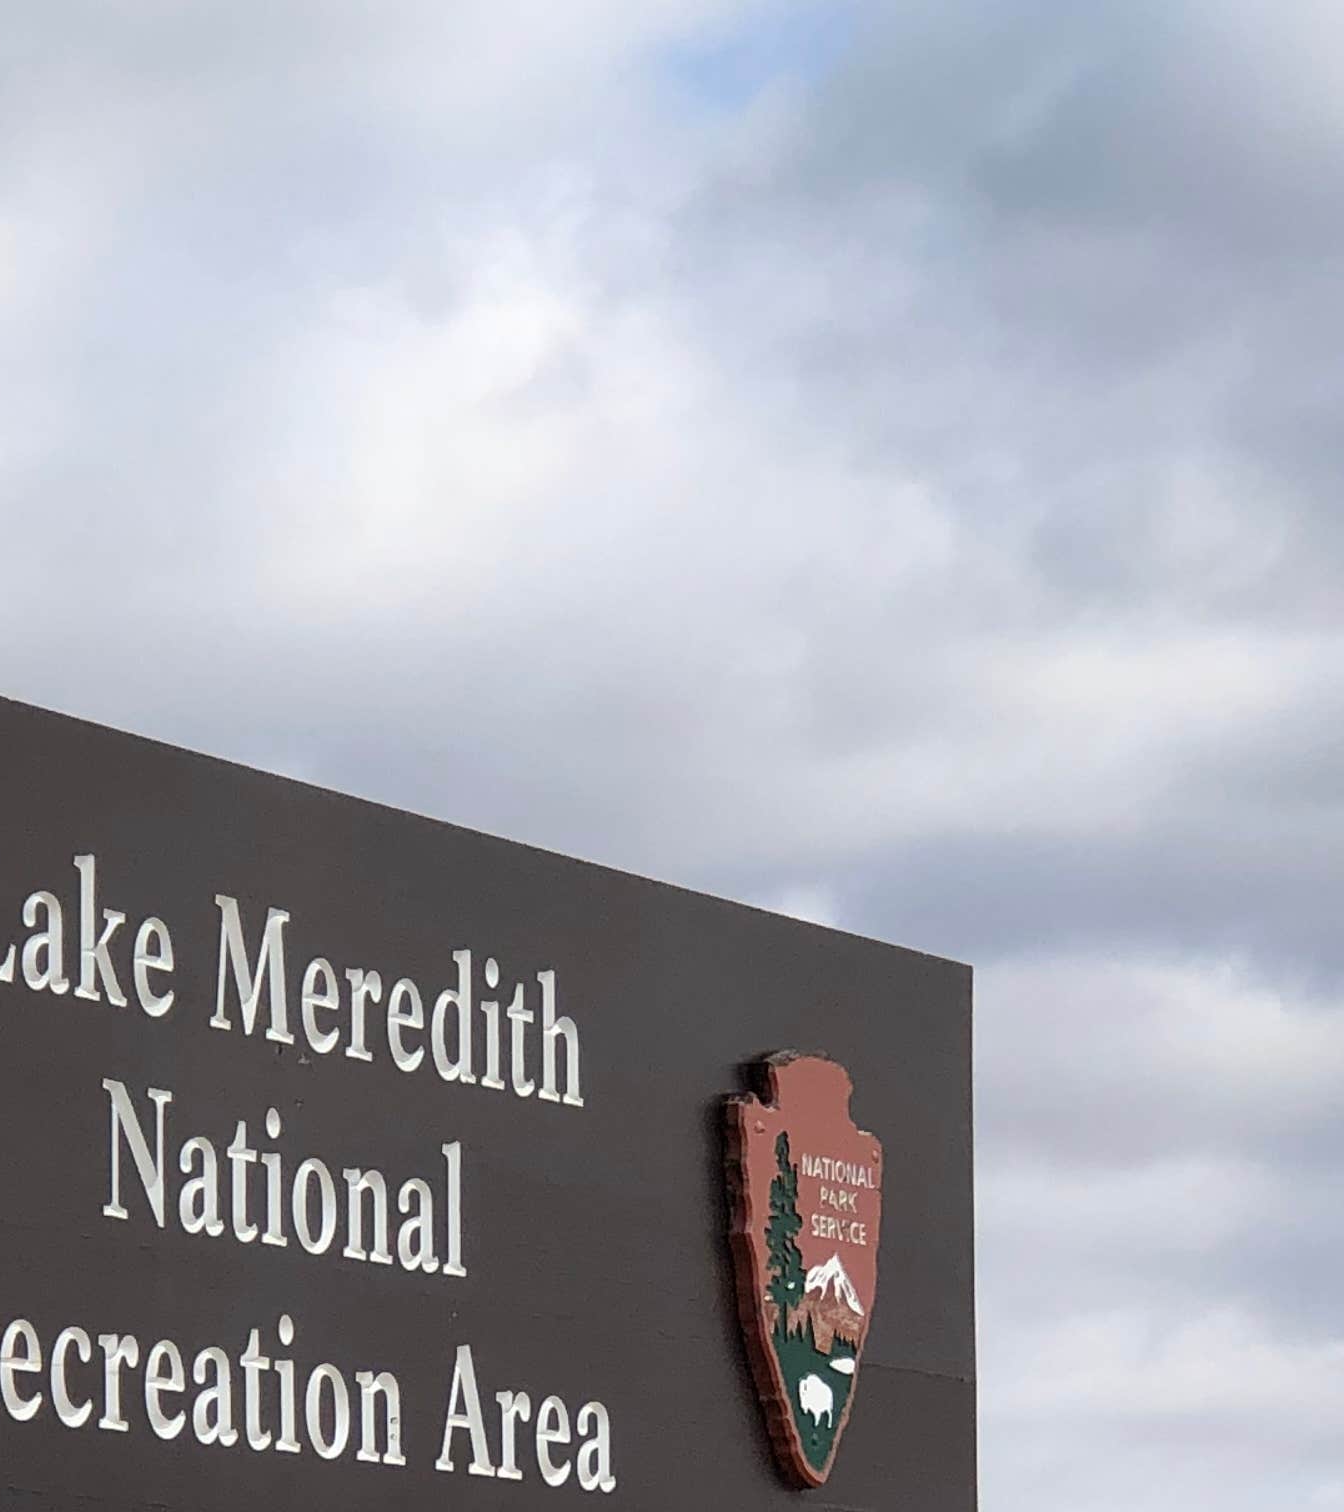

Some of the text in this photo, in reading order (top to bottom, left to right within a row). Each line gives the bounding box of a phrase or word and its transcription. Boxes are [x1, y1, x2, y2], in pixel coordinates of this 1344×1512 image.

[209, 893, 585, 1108] Meredith
[102, 1077, 467, 1278] National
[801, 1153, 875, 1189] NATIONAL
[819, 1186, 858, 1214] PARK
[434, 1344, 617, 1494] Area
